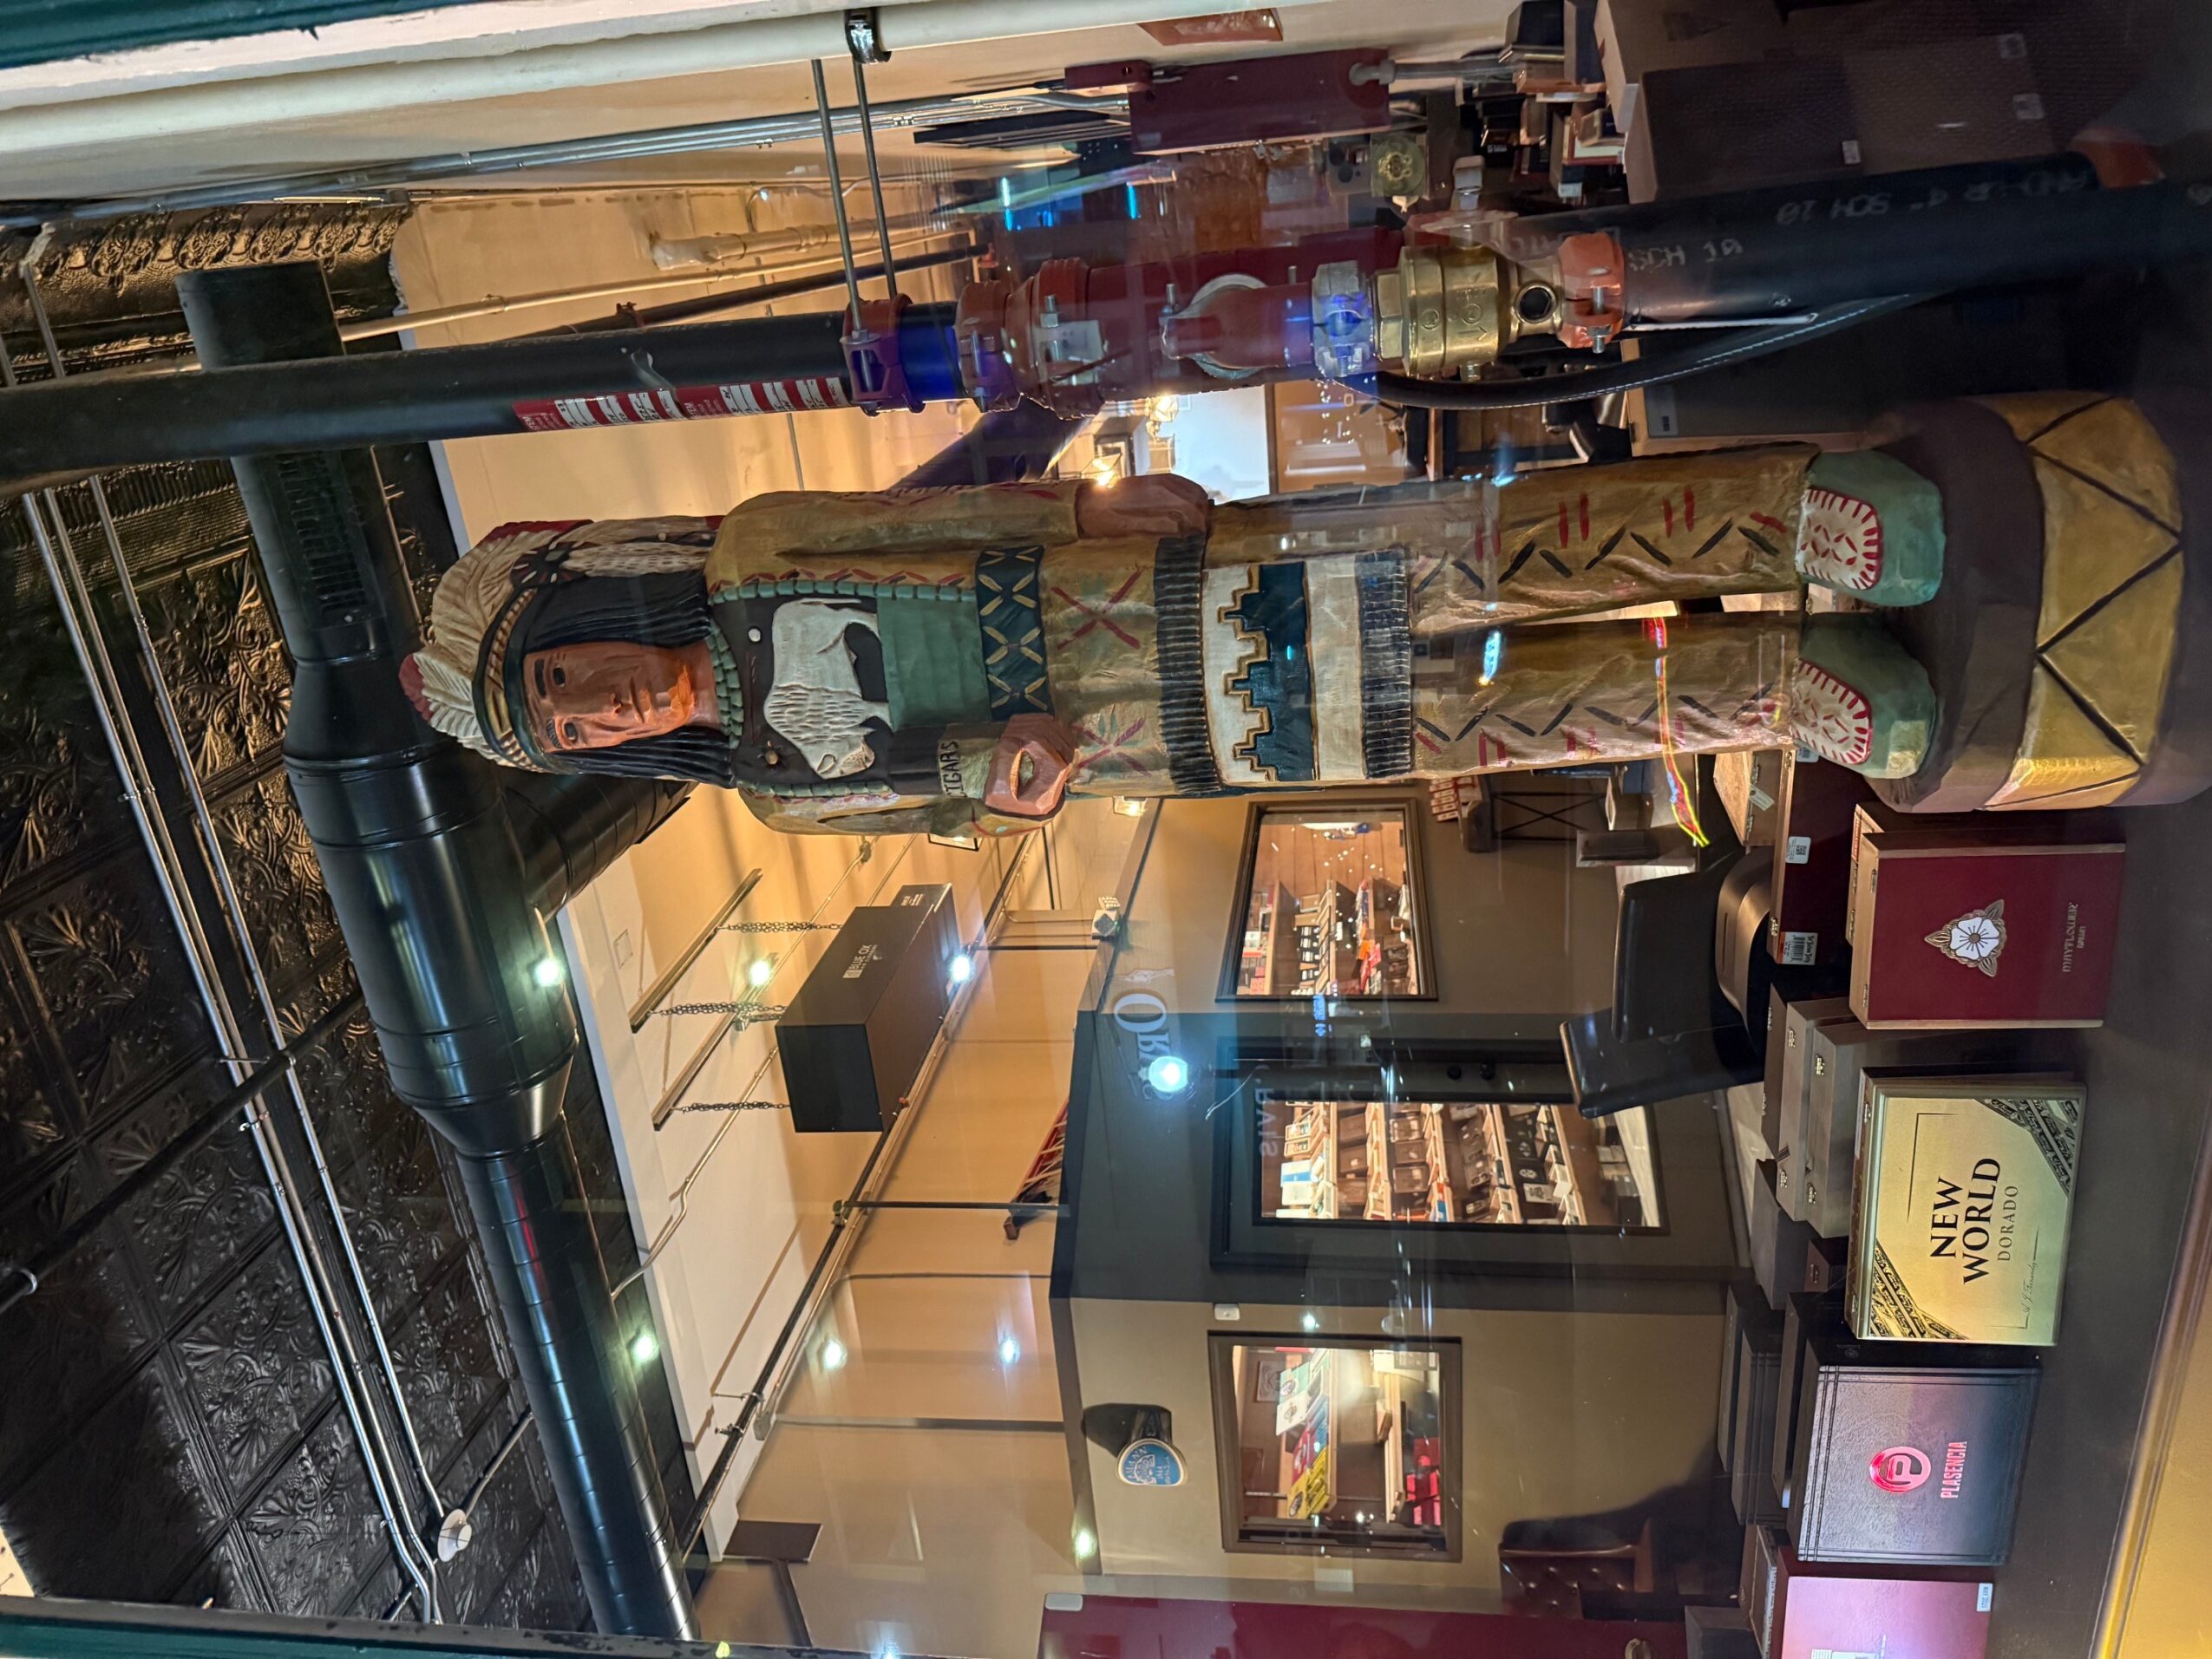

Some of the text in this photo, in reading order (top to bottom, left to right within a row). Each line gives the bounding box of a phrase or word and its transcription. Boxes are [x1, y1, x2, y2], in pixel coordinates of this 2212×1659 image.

[1829, 191, 1892, 219] SCH
[939, 741, 968, 798] CIGARS
[847, 955, 867, 970] BLUE
[857, 944, 873, 955] OX
[2061, 901, 2079, 972] MAYFLOWER
[1929, 1175, 1964, 1259] NEW
[1961, 1158, 2002, 1285] WORLD
[1997, 1185, 2019, 1262] DORADO
[1940, 1440, 1968, 1499] PLASENCIA
